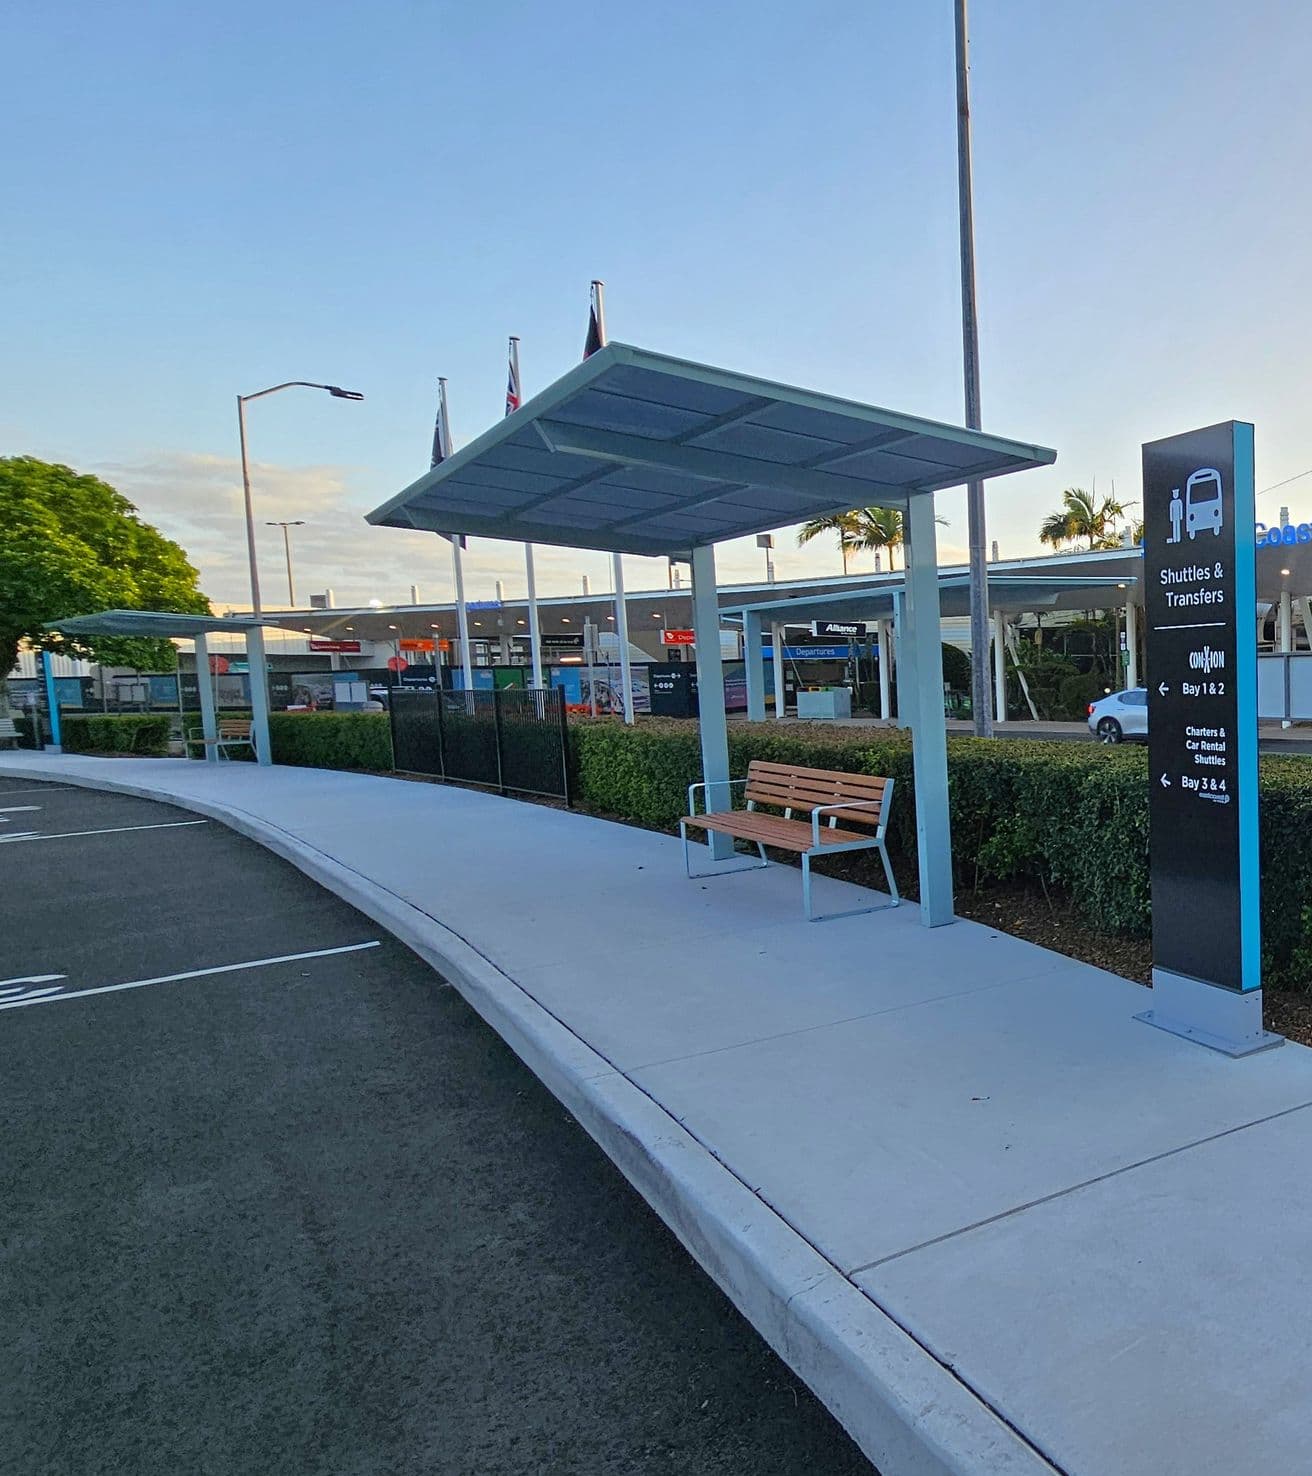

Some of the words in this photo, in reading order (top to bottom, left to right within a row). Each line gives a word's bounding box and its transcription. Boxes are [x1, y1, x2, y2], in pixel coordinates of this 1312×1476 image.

[1160, 565, 1211, 585] Shuttles
[1214, 562, 1224, 578] &
[1165, 588, 1224, 608] Transfers
[825, 624, 858, 633] Alliance
[795, 647, 835, 657] Departures
[1182, 683, 1201, 697] Bay
[1202, 683, 1208, 695] 1
[1209, 683, 1217, 695] &
[1218, 683, 1225, 695] 2
[1185, 726, 1218, 738] Charters
[1219, 727, 1226, 738] &
[1185, 740, 1200, 750] Car
[1201, 740, 1226, 751] Rental
[1194, 754, 1226, 766] Shuttles
[1182, 776, 1200, 791] Bay
[1201, 777, 1208, 790] 3
[1210, 778, 1218, 791] &
[1218, 779, 1226, 792] 4
